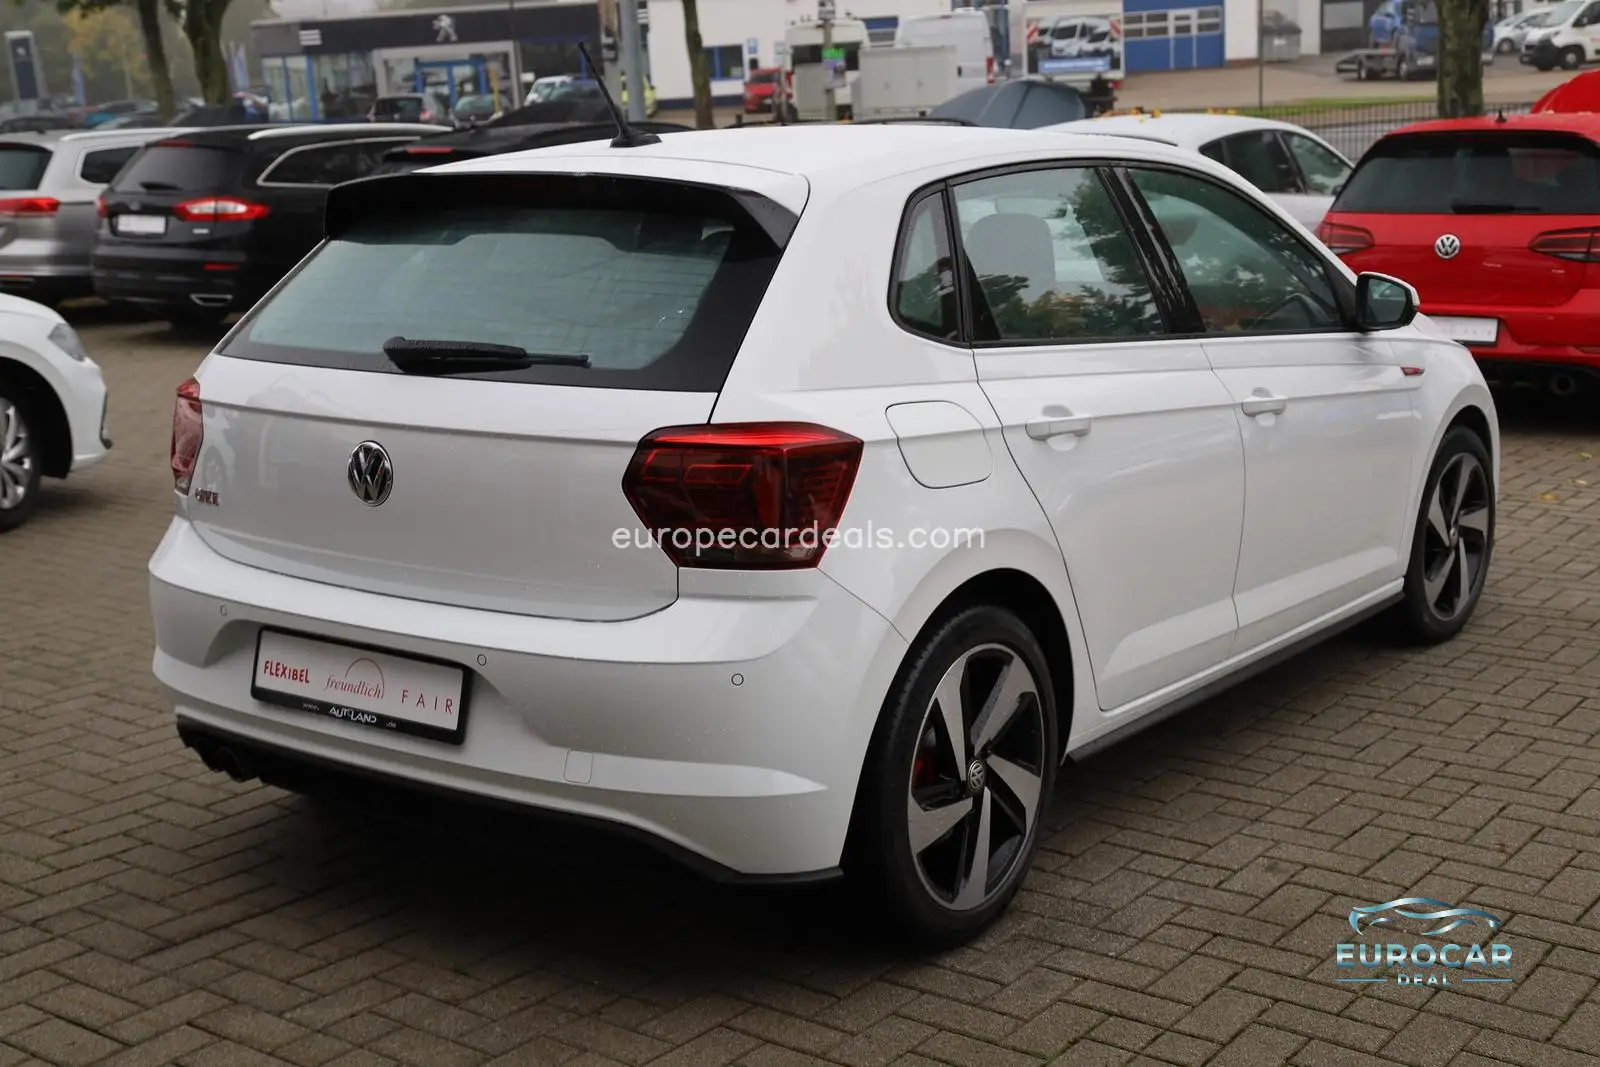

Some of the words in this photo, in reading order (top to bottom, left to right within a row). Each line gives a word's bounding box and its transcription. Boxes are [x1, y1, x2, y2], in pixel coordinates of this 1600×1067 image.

[348, 440, 393, 507] VW
[263, 660, 310, 684] FLEXIBEL
[324, 673, 385, 700] freundlich
[401, 689, 454, 714] FAIR
